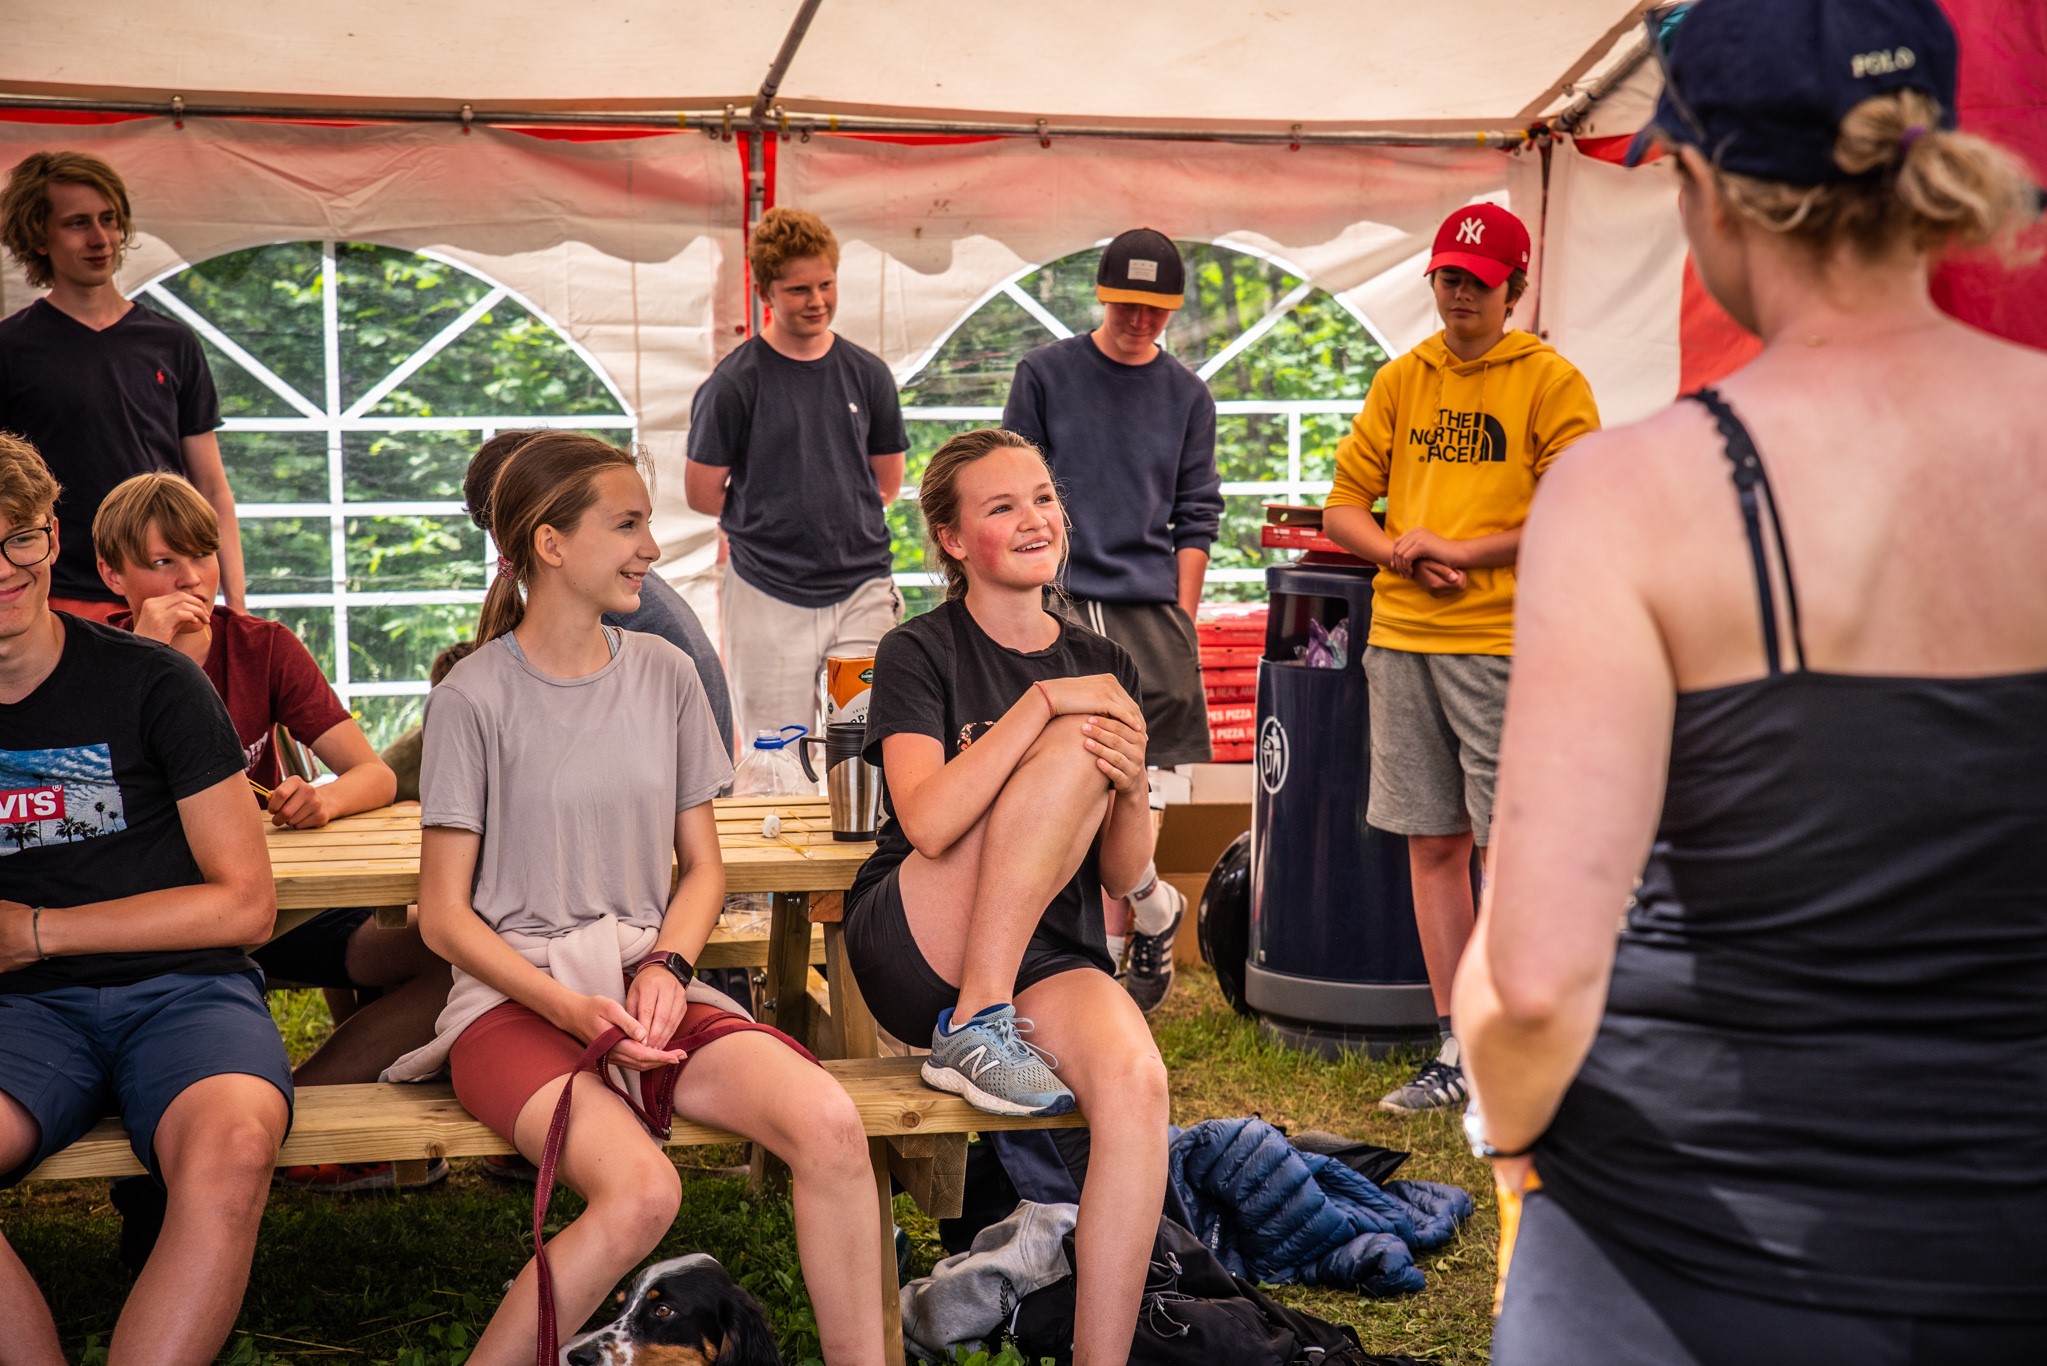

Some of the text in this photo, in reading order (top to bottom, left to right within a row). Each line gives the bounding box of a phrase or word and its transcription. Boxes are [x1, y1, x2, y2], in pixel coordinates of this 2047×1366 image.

[1850, 46, 1916, 79] POLO
[1455, 216, 1486, 245] NY
[1439, 409, 1473, 429] THE
[1409, 427, 1471, 446] NORTH
[1427, 444, 1469, 463] FACE
[1225, 708, 1253, 720] PIZZA
[1216, 727, 1245, 739] PIZZA
